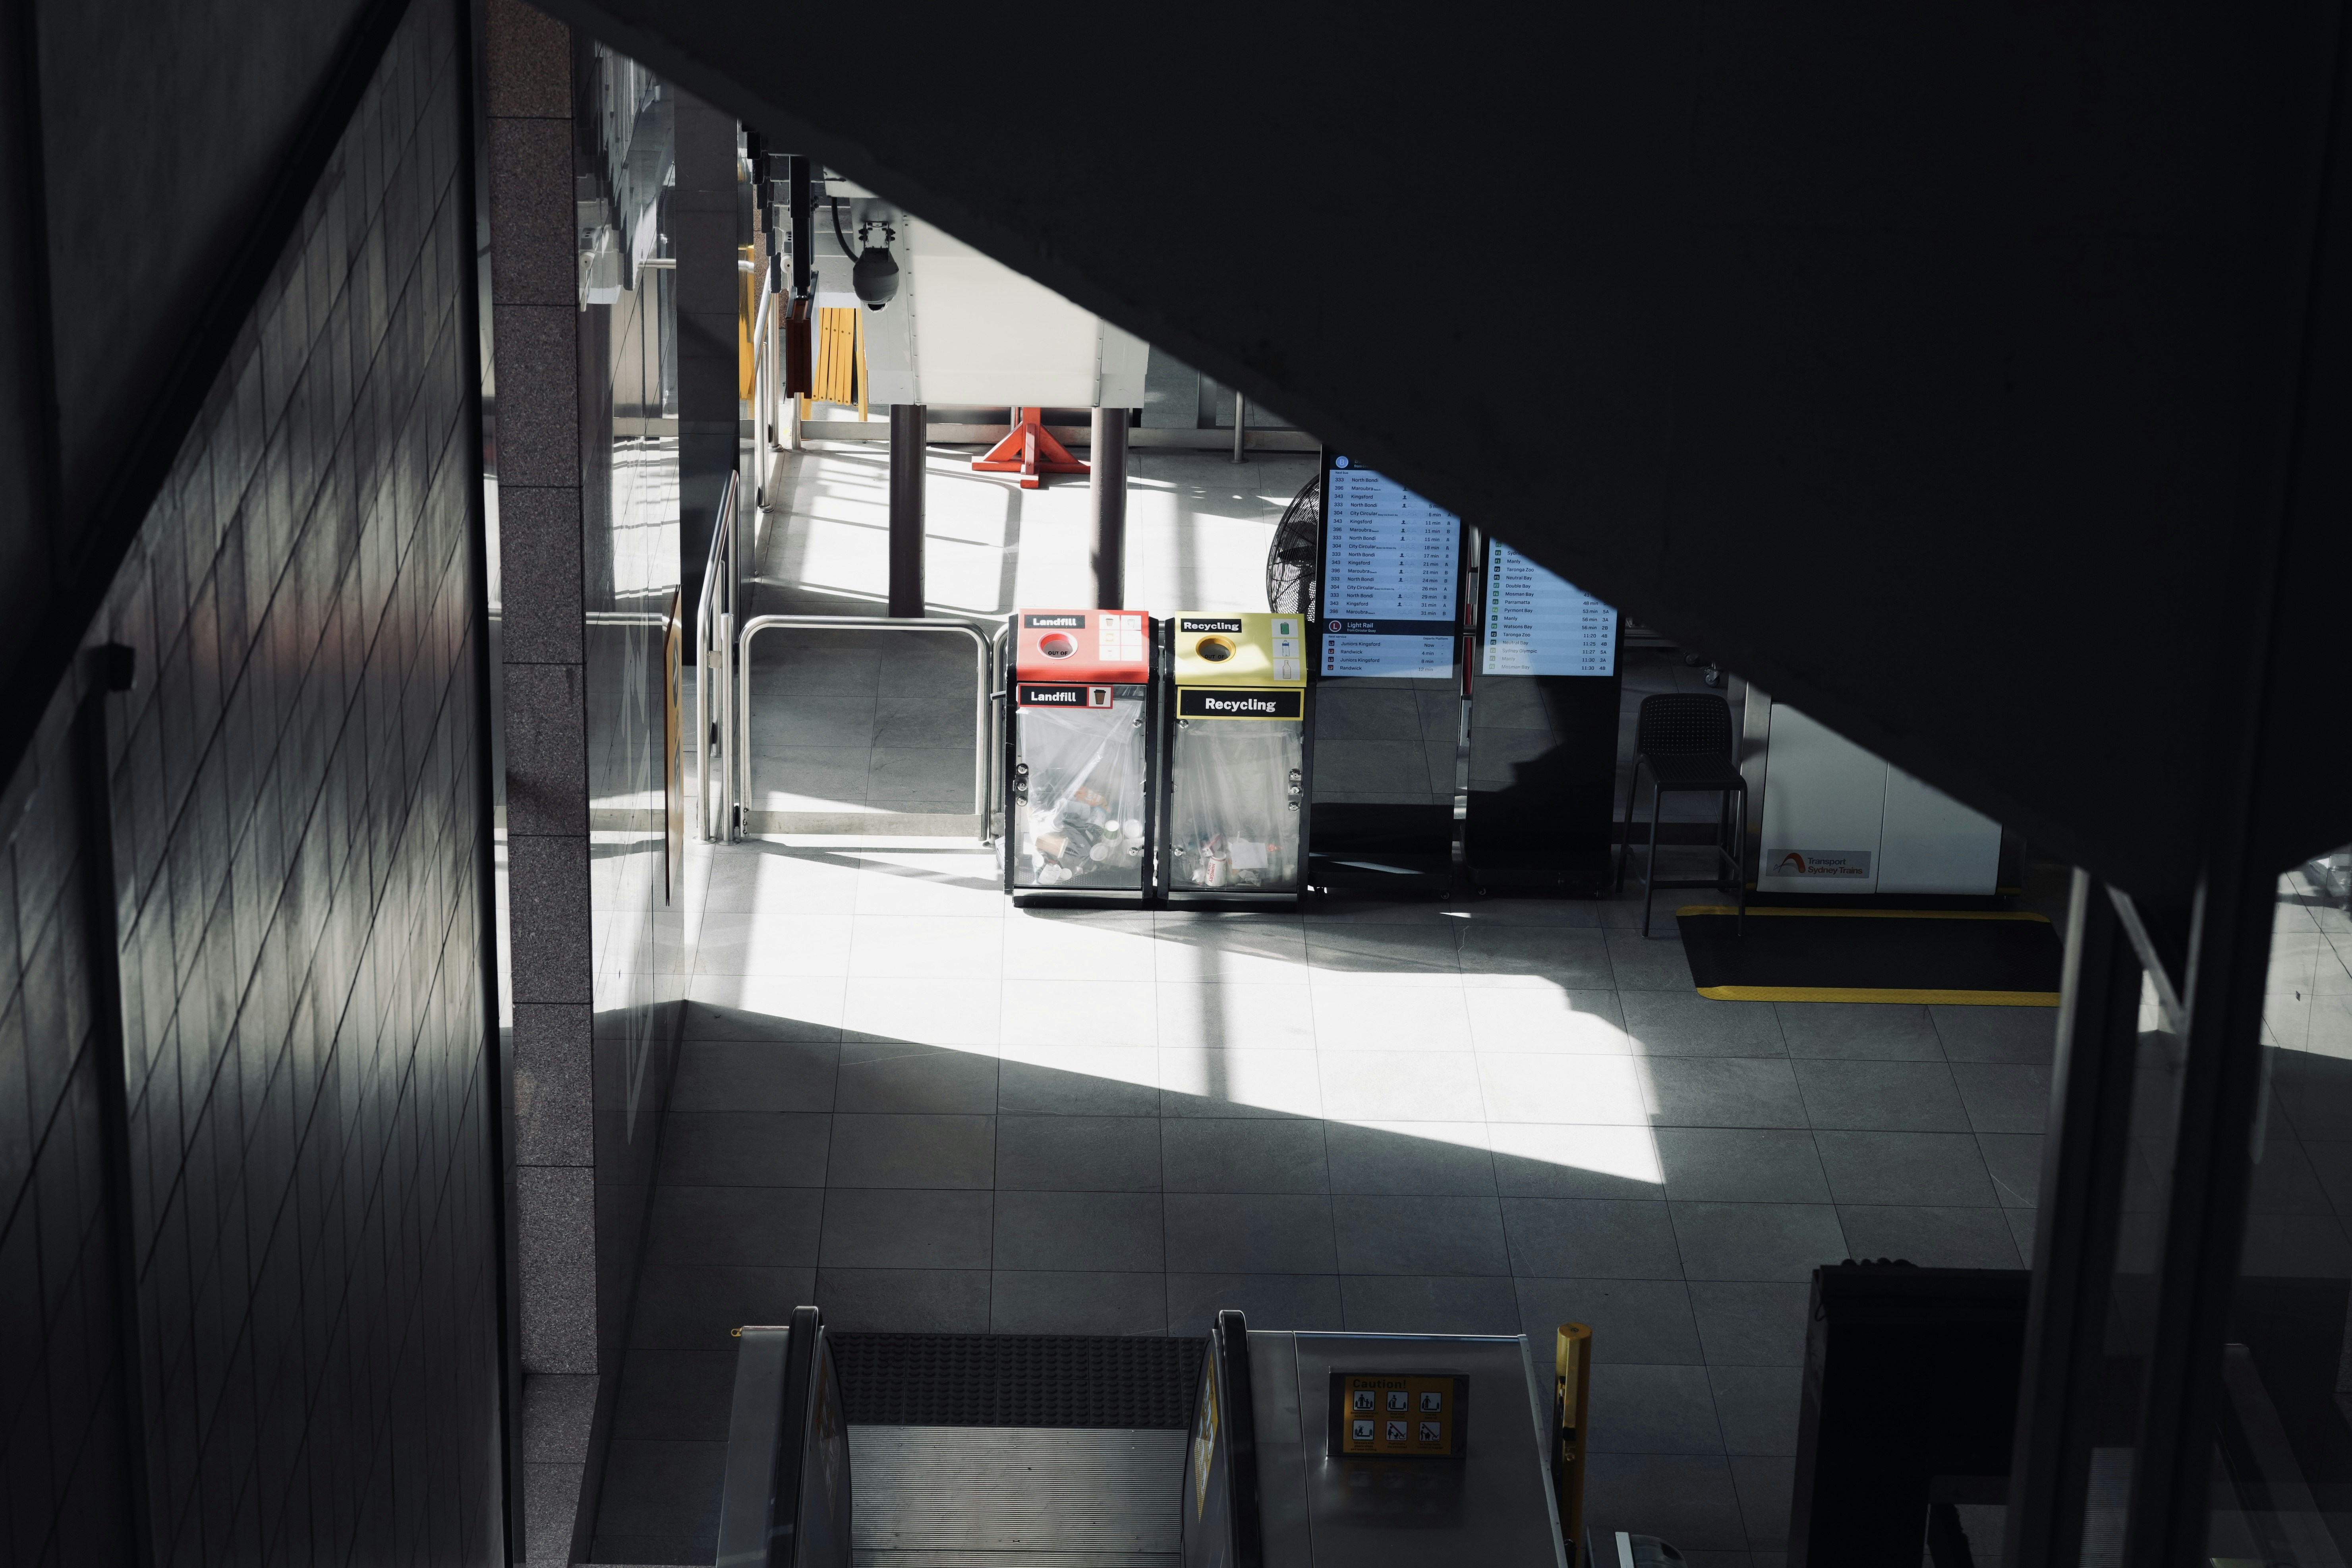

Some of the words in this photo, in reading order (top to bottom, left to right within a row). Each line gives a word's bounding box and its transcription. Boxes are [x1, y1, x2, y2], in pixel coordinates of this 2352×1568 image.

[1184, 622, 1239, 631] Recycling
[1031, 692, 1076, 702] Landfill
[1206, 698, 1276, 712] Recycling
[1353, 1379, 1406, 1388] Caution!
